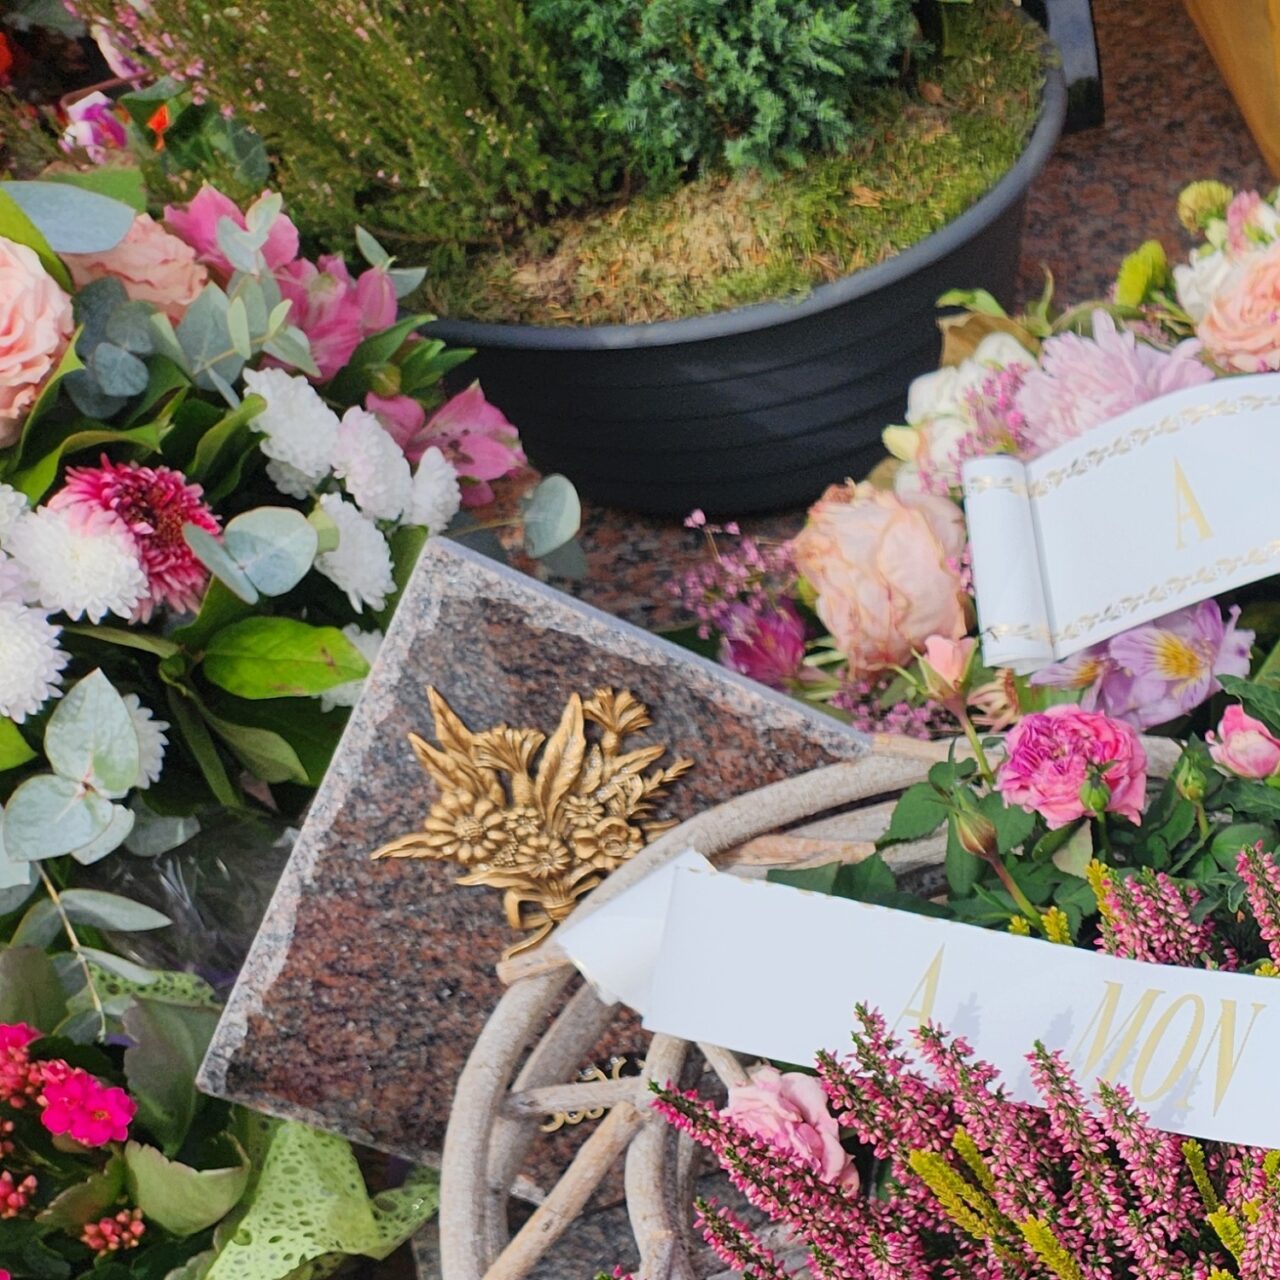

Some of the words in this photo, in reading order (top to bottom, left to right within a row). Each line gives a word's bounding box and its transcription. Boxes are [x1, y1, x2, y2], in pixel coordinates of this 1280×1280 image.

[1174, 457, 1214, 550] A
[889, 942, 945, 1048] A
[1070, 980, 1268, 1118] MON
